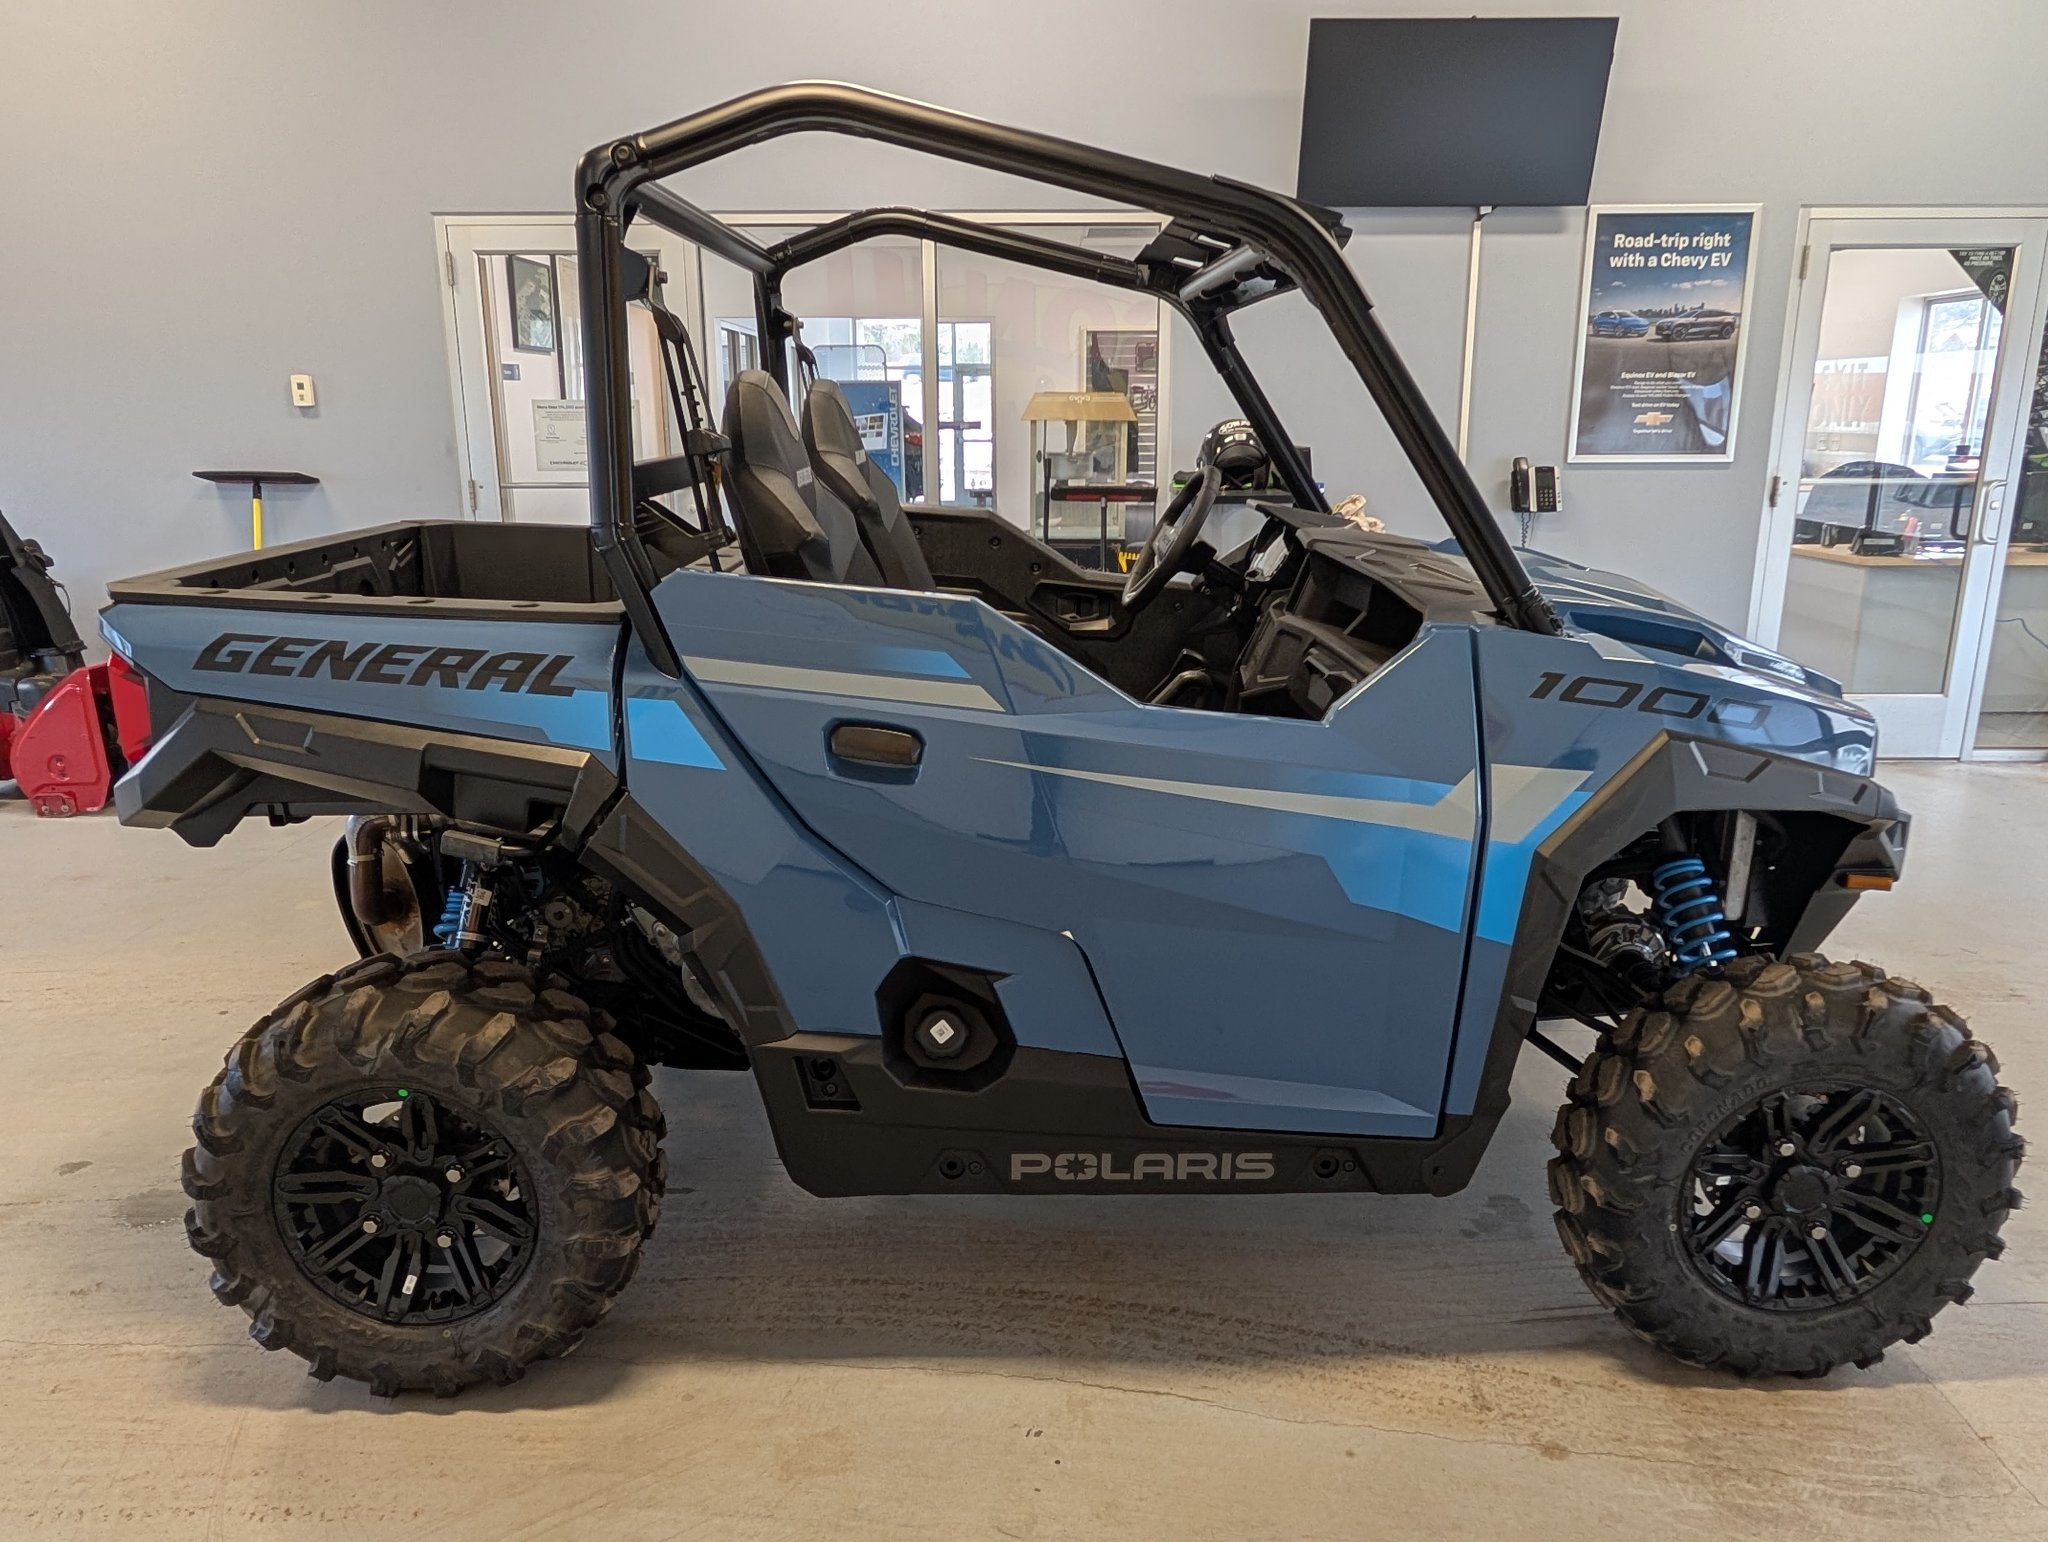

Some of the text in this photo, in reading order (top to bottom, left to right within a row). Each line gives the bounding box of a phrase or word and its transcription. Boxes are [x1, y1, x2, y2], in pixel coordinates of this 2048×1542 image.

[1609, 252, 1732, 270] with a Chevy EV
[1613, 232, 1731, 251] Road-trip right
[889, 386, 899, 467] CHEVROLET
[192, 632, 576, 698] GENERAL
[1529, 671, 1773, 731] 1000
[1010, 1152, 1275, 1181] POLARIS
